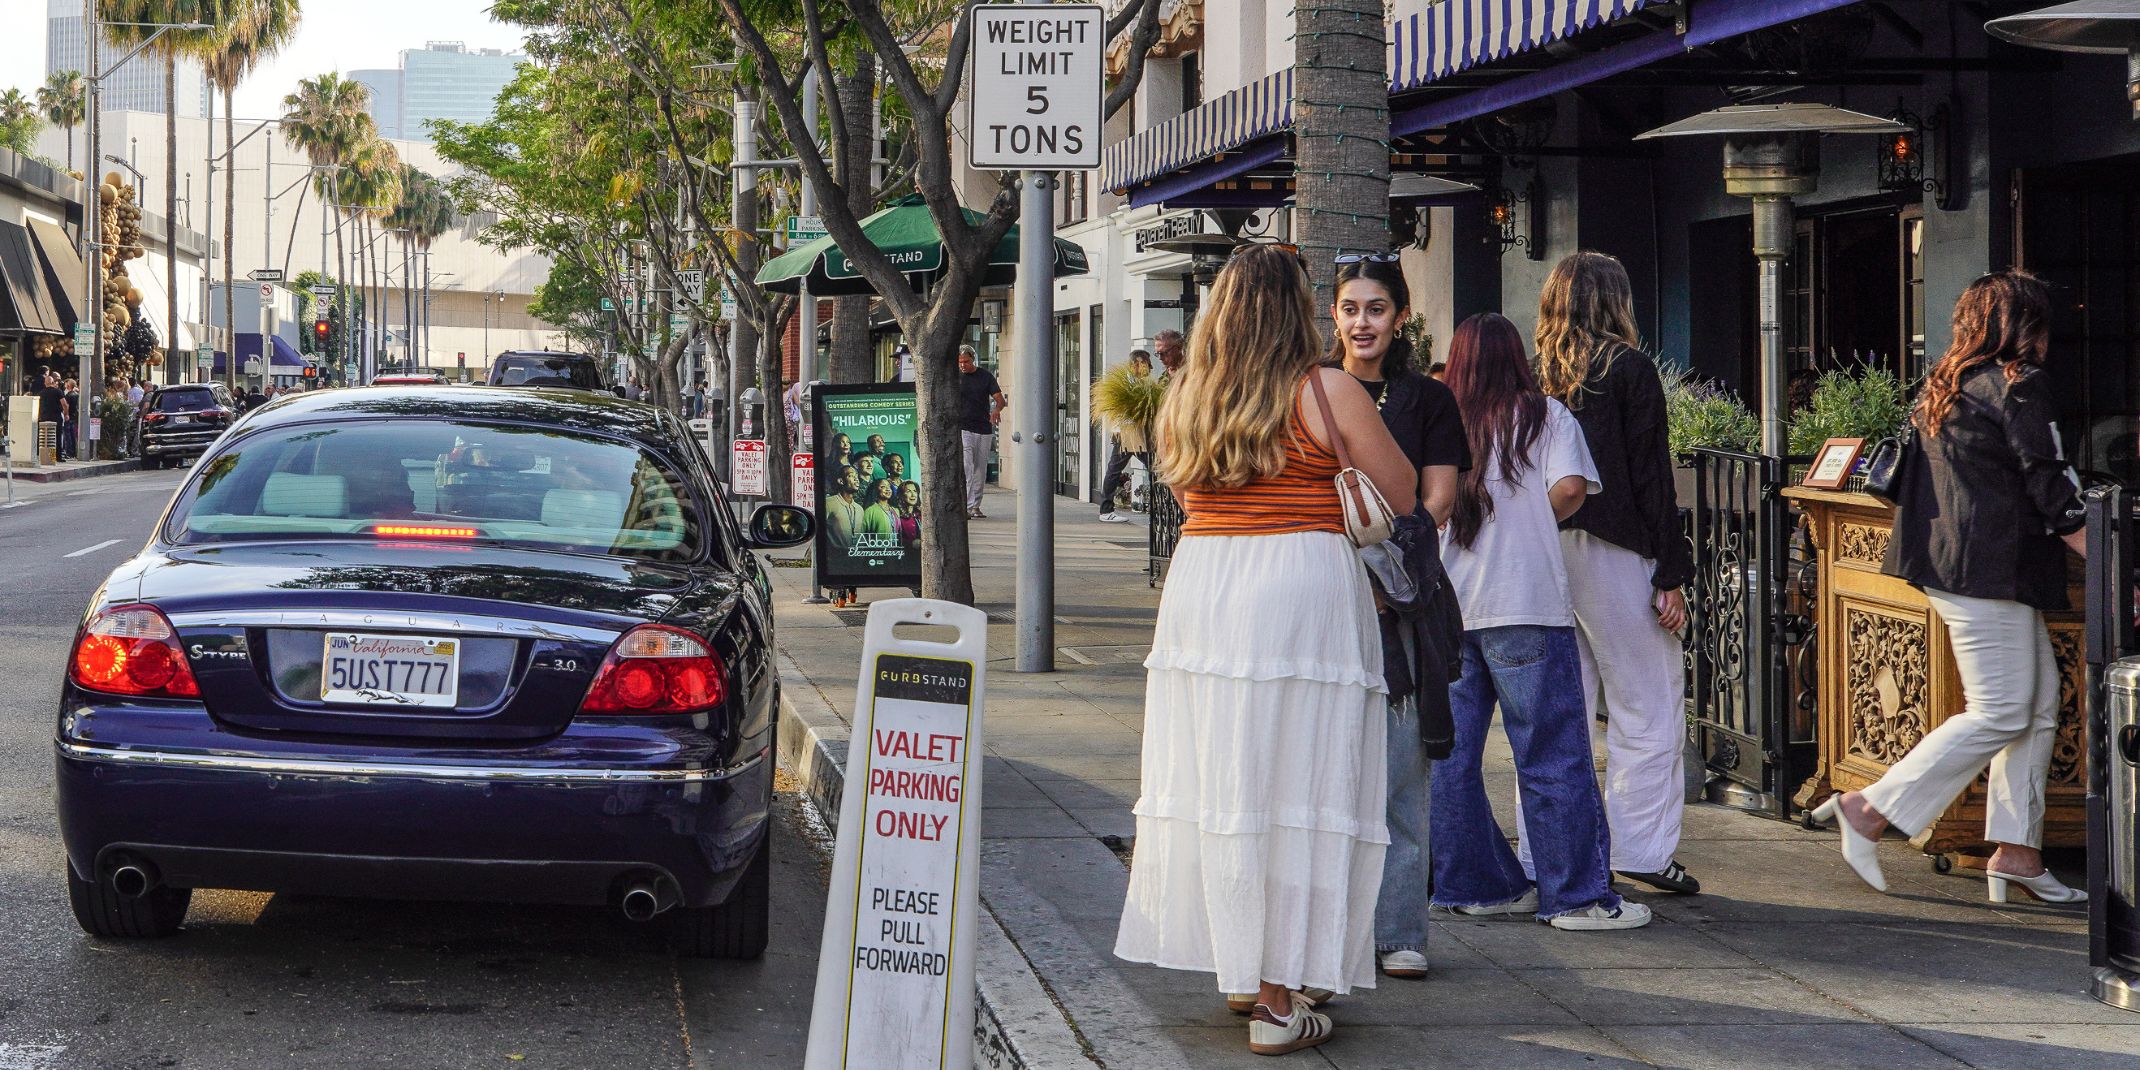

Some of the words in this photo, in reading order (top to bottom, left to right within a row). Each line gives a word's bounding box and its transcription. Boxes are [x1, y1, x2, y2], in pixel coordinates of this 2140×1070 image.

[987, 20, 1089, 43] WEIGHT
[1001, 52, 1073, 75] LIMIT
[1026, 86, 1049, 114] 5
[989, 125, 1083, 154] TONS
[843, 251, 923, 272] CTAND
[677, 273, 700, 283] ONE
[687, 285, 700, 294] AY
[855, 533, 899, 548] Abbott
[848, 547, 904, 560] Elementary
[332, 640, 348, 649] JUN
[351, 640, 434, 658] California
[332, 657, 449, 694] 5UST777
[554, 660, 577, 671] 3.0
[880, 670, 967, 688] CURBSTAND
[875, 729, 962, 762] VALET
[870, 768, 960, 803] PARKING
[876, 810, 948, 842] ONLY
[872, 888, 939, 915] PLEASE
[881, 919, 925, 945] PULL
[856, 947, 945, 976] FORWARD
